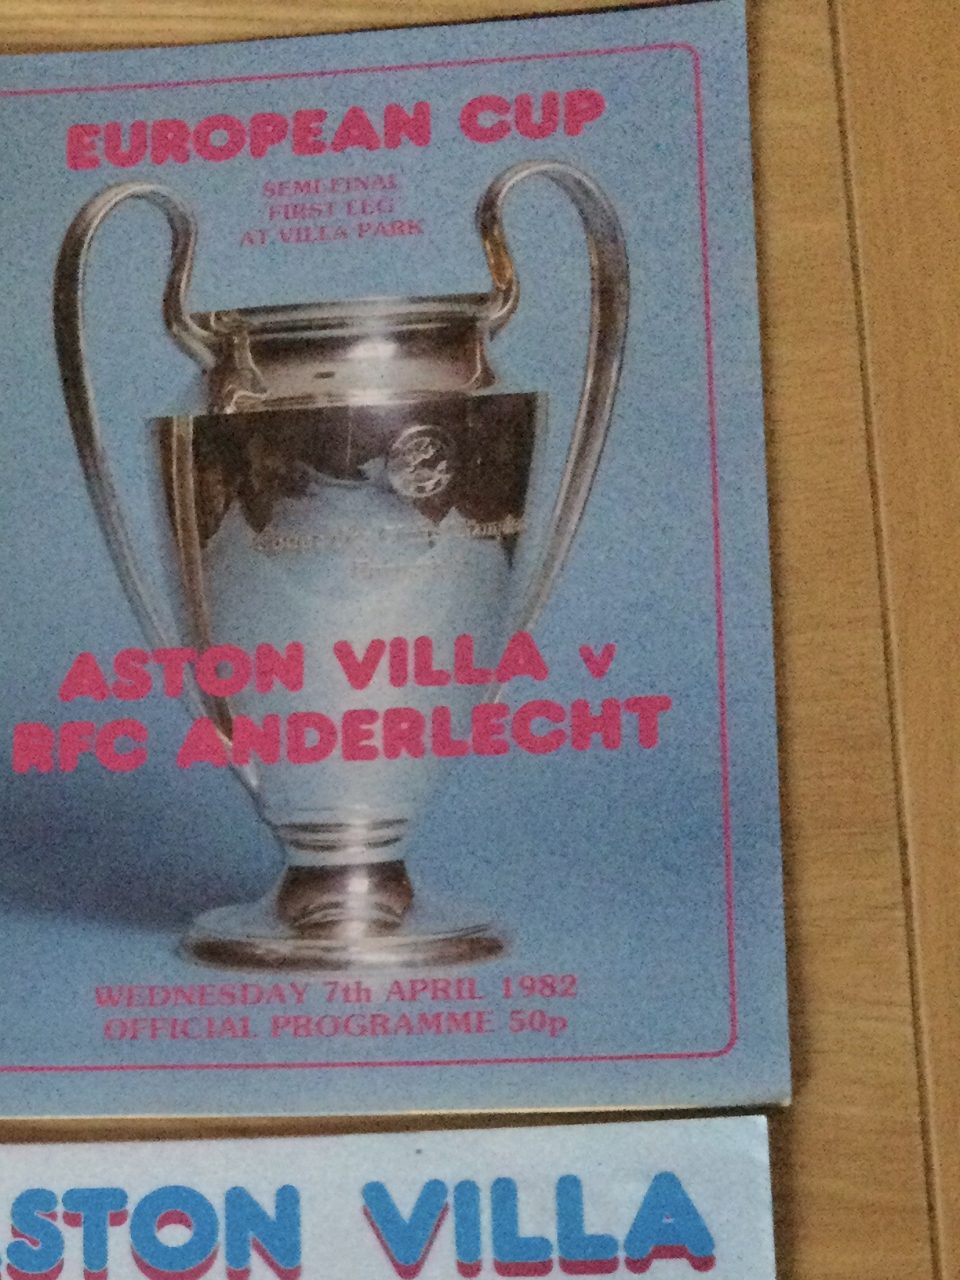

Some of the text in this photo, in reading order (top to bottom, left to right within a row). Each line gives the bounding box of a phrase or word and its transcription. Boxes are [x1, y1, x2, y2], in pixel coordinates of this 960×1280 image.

[65, 88, 606, 171] EUROPEAN CUP
[241, 220, 424, 246] AT VILLA PARK
[268, 202, 334, 220] FIRST
[58, 631, 617, 702] ASTON VILLA v
[12, 695, 672, 774] RFC ANDERLECHT
[95, 974, 578, 1009] WEDNESDAY 7th APRIL 1982
[103, 1009, 569, 1041] OFFICIAL PROGRAMME 50p
[360, 1171, 717, 1280] VILLA
